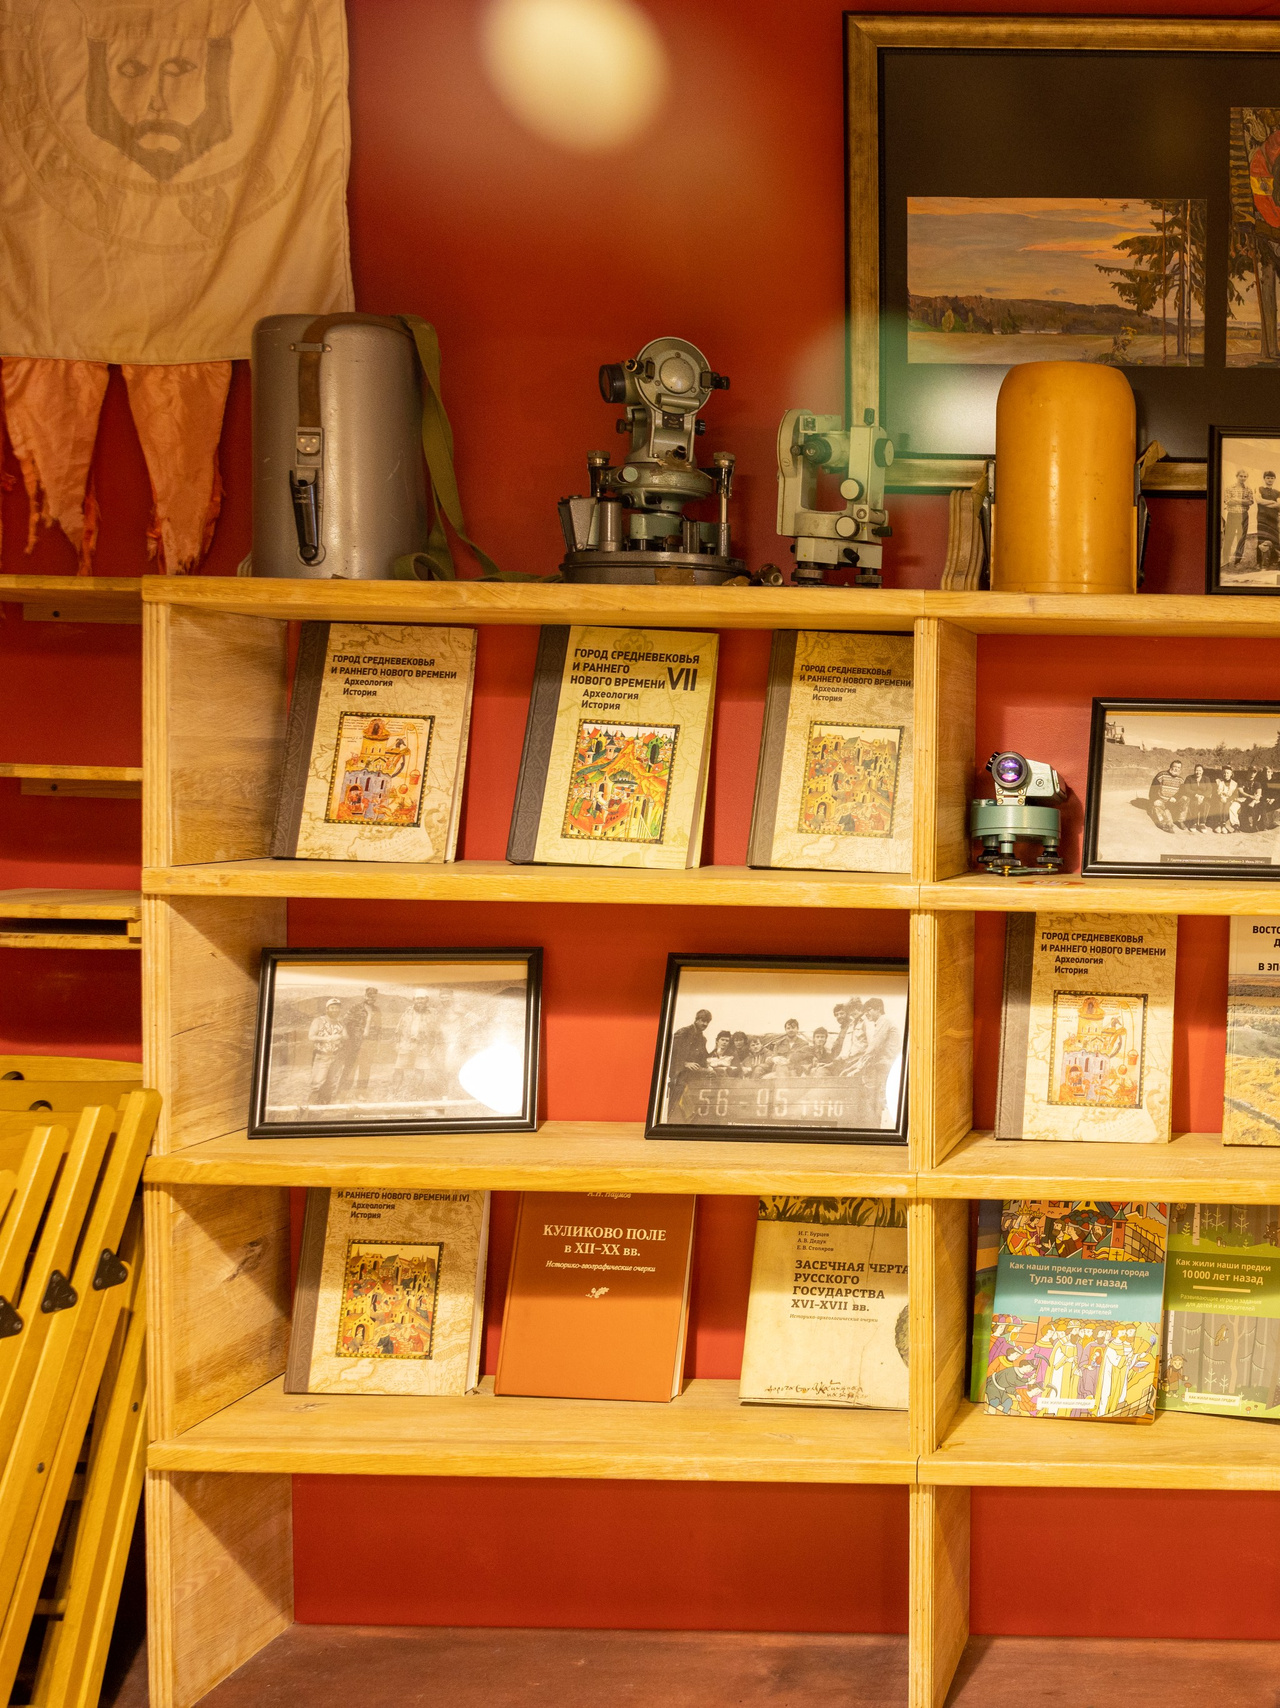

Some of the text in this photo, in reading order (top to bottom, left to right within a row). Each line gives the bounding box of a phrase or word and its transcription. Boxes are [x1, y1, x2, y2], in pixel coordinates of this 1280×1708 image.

[333, 655, 435, 666] ГОРОД СРЕДНЕВЕКОВЬЯ
[574, 648, 700, 664] ГОРОД СРЕДНЕВЕКОВЬЯ
[339, 667, 378, 676] РАННЕГО
[380, 669, 413, 677] НОВОГО
[416, 670, 457, 679] ВРЕМЕНИ
[572, 662, 630, 674] И РАННЕГО
[344, 678, 393, 687] Археология
[570, 675, 665, 689] НОВОГО ВРЕМЕНИ
[667, 667, 698, 691] VII
[343, 688, 377, 697] История
[583, 689, 639, 700] Археология
[581, 700, 620, 711] История
[1042, 932, 1143, 943] ГОРОД СРЕДНЕВЕКОВЬЯ
[1049, 944, 1087, 953] РАННЕГО
[1090, 946, 1123, 954] НОВОГО
[1125, 948, 1166, 956] ВРЕМЕНИ
[1055, 955, 1103, 964] Археология
[1054, 966, 1088, 975] История
[543, 1224, 667, 1241] КУЛИКОВО ПОЛЕ
[564, 1245, 572, 1253] в
[623, 1248, 640, 1256] вв.
[795, 1260, 908, 1274] ЗАСЕЧНАЯ ЧЕРТА
[1052, 1265, 1082, 1274] предки
[1084, 1267, 1118, 1275] строили
[1121, 1269, 1149, 1277] города
[1241, 1264, 1271, 1272] предки
[794, 1273, 859, 1284] РУССКОГО
[1029, 1274, 1128, 1289] Тула 500 лет назад
[1212, 1273, 1230, 1281] лет
[1233, 1275, 1264, 1285] назад
[792, 1286, 885, 1299] ГОСУДАРСТВА
